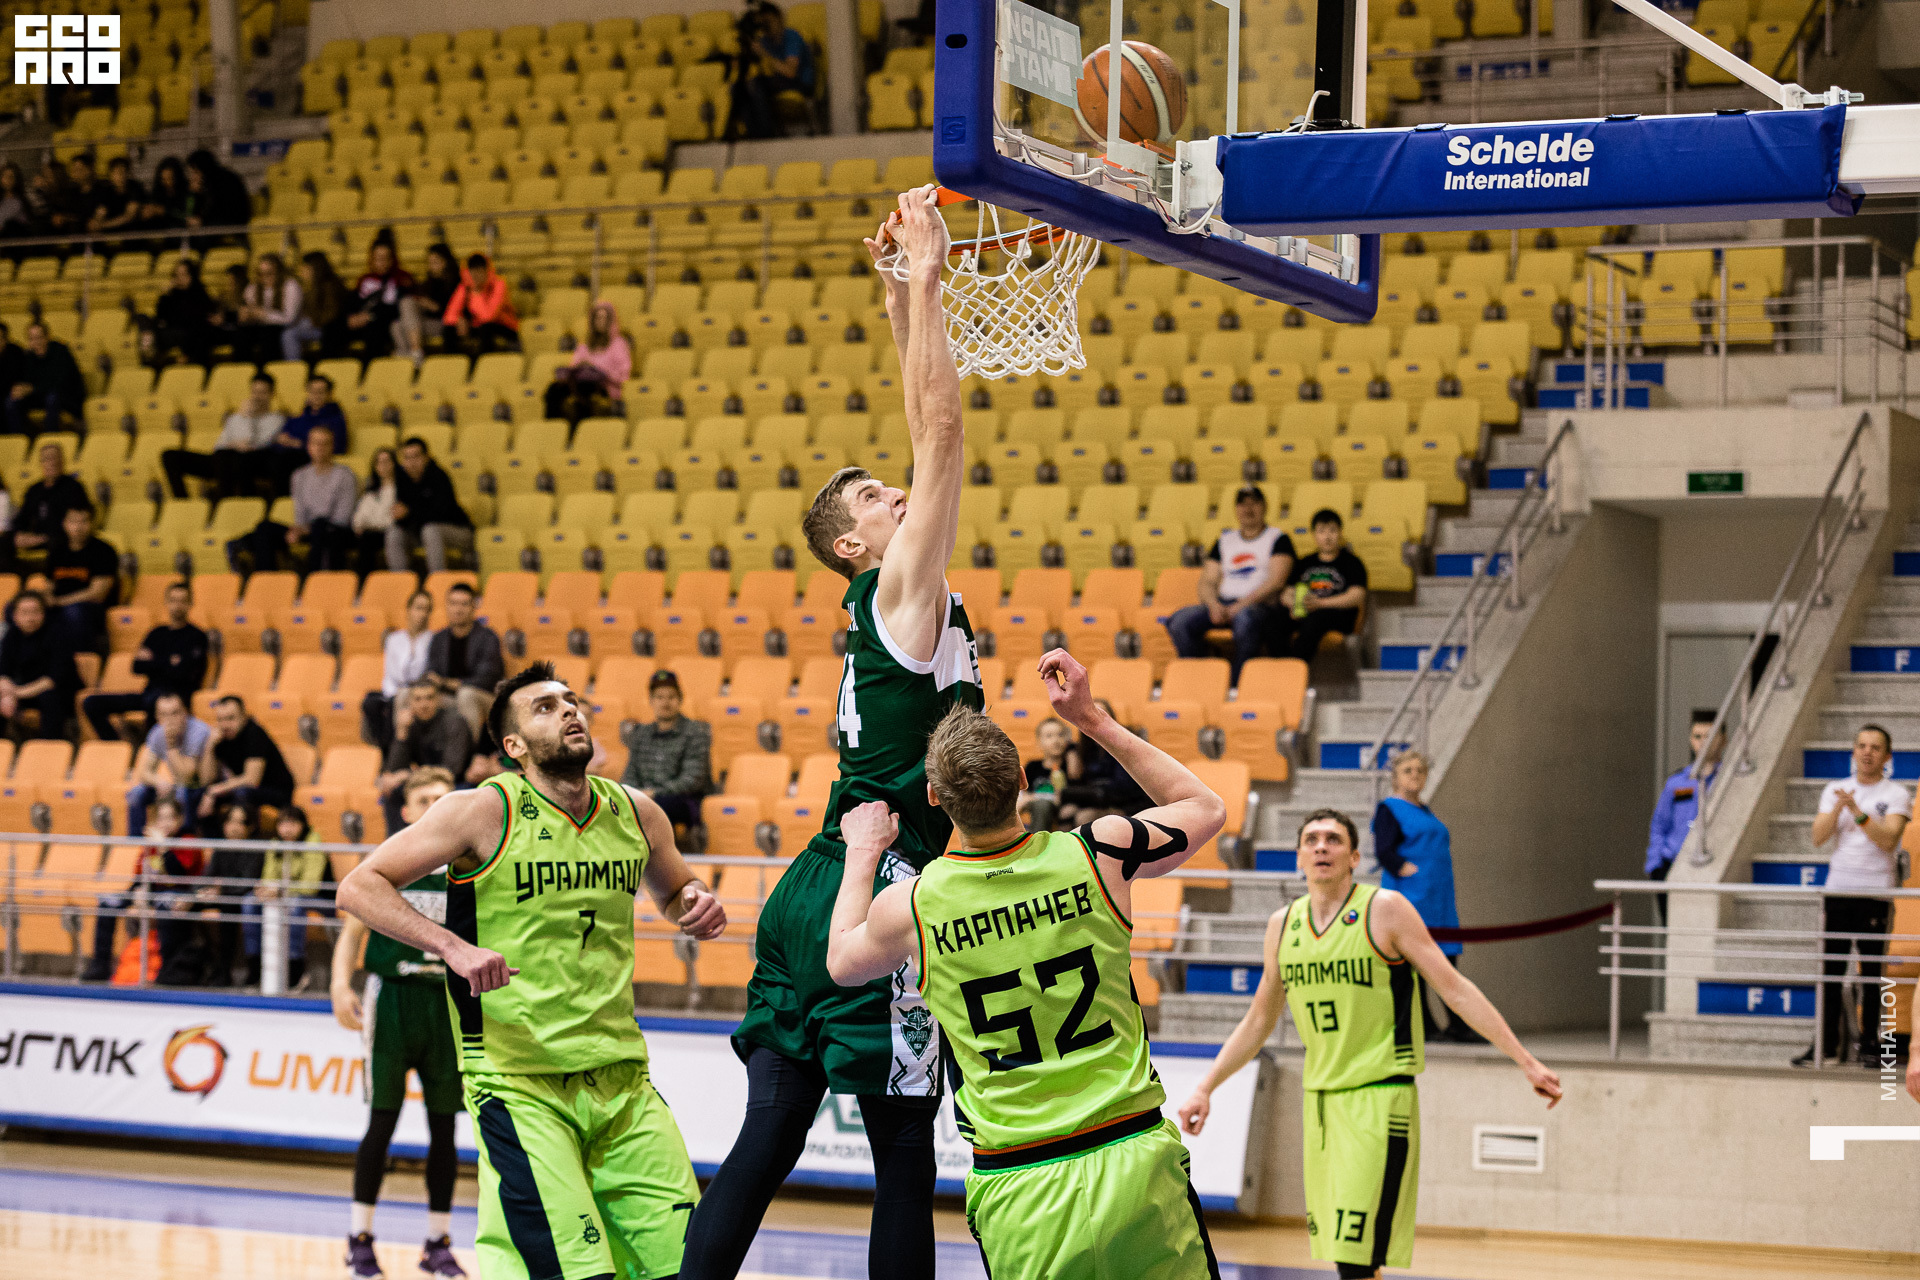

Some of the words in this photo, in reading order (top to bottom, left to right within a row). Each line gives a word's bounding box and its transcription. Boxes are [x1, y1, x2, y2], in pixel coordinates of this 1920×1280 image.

[1447, 133, 1594, 166] Schelde
[1444, 167, 1590, 190] International
[515, 859, 643, 904] УРАЛМАШ
[578, 910, 597, 949] 7
[931, 881, 1093, 955] КАРПАЧЕВ
[1231, 968, 1249, 992] E
[1283, 957, 1373, 994] РАЛМАШ
[959, 943, 1115, 1075] 52
[1306, 1001, 1339, 1033] 13
[1747, 987, 1764, 1012] F
[1779, 988, 1792, 1013] 1
[1336, 1209, 1367, 1243] 13
